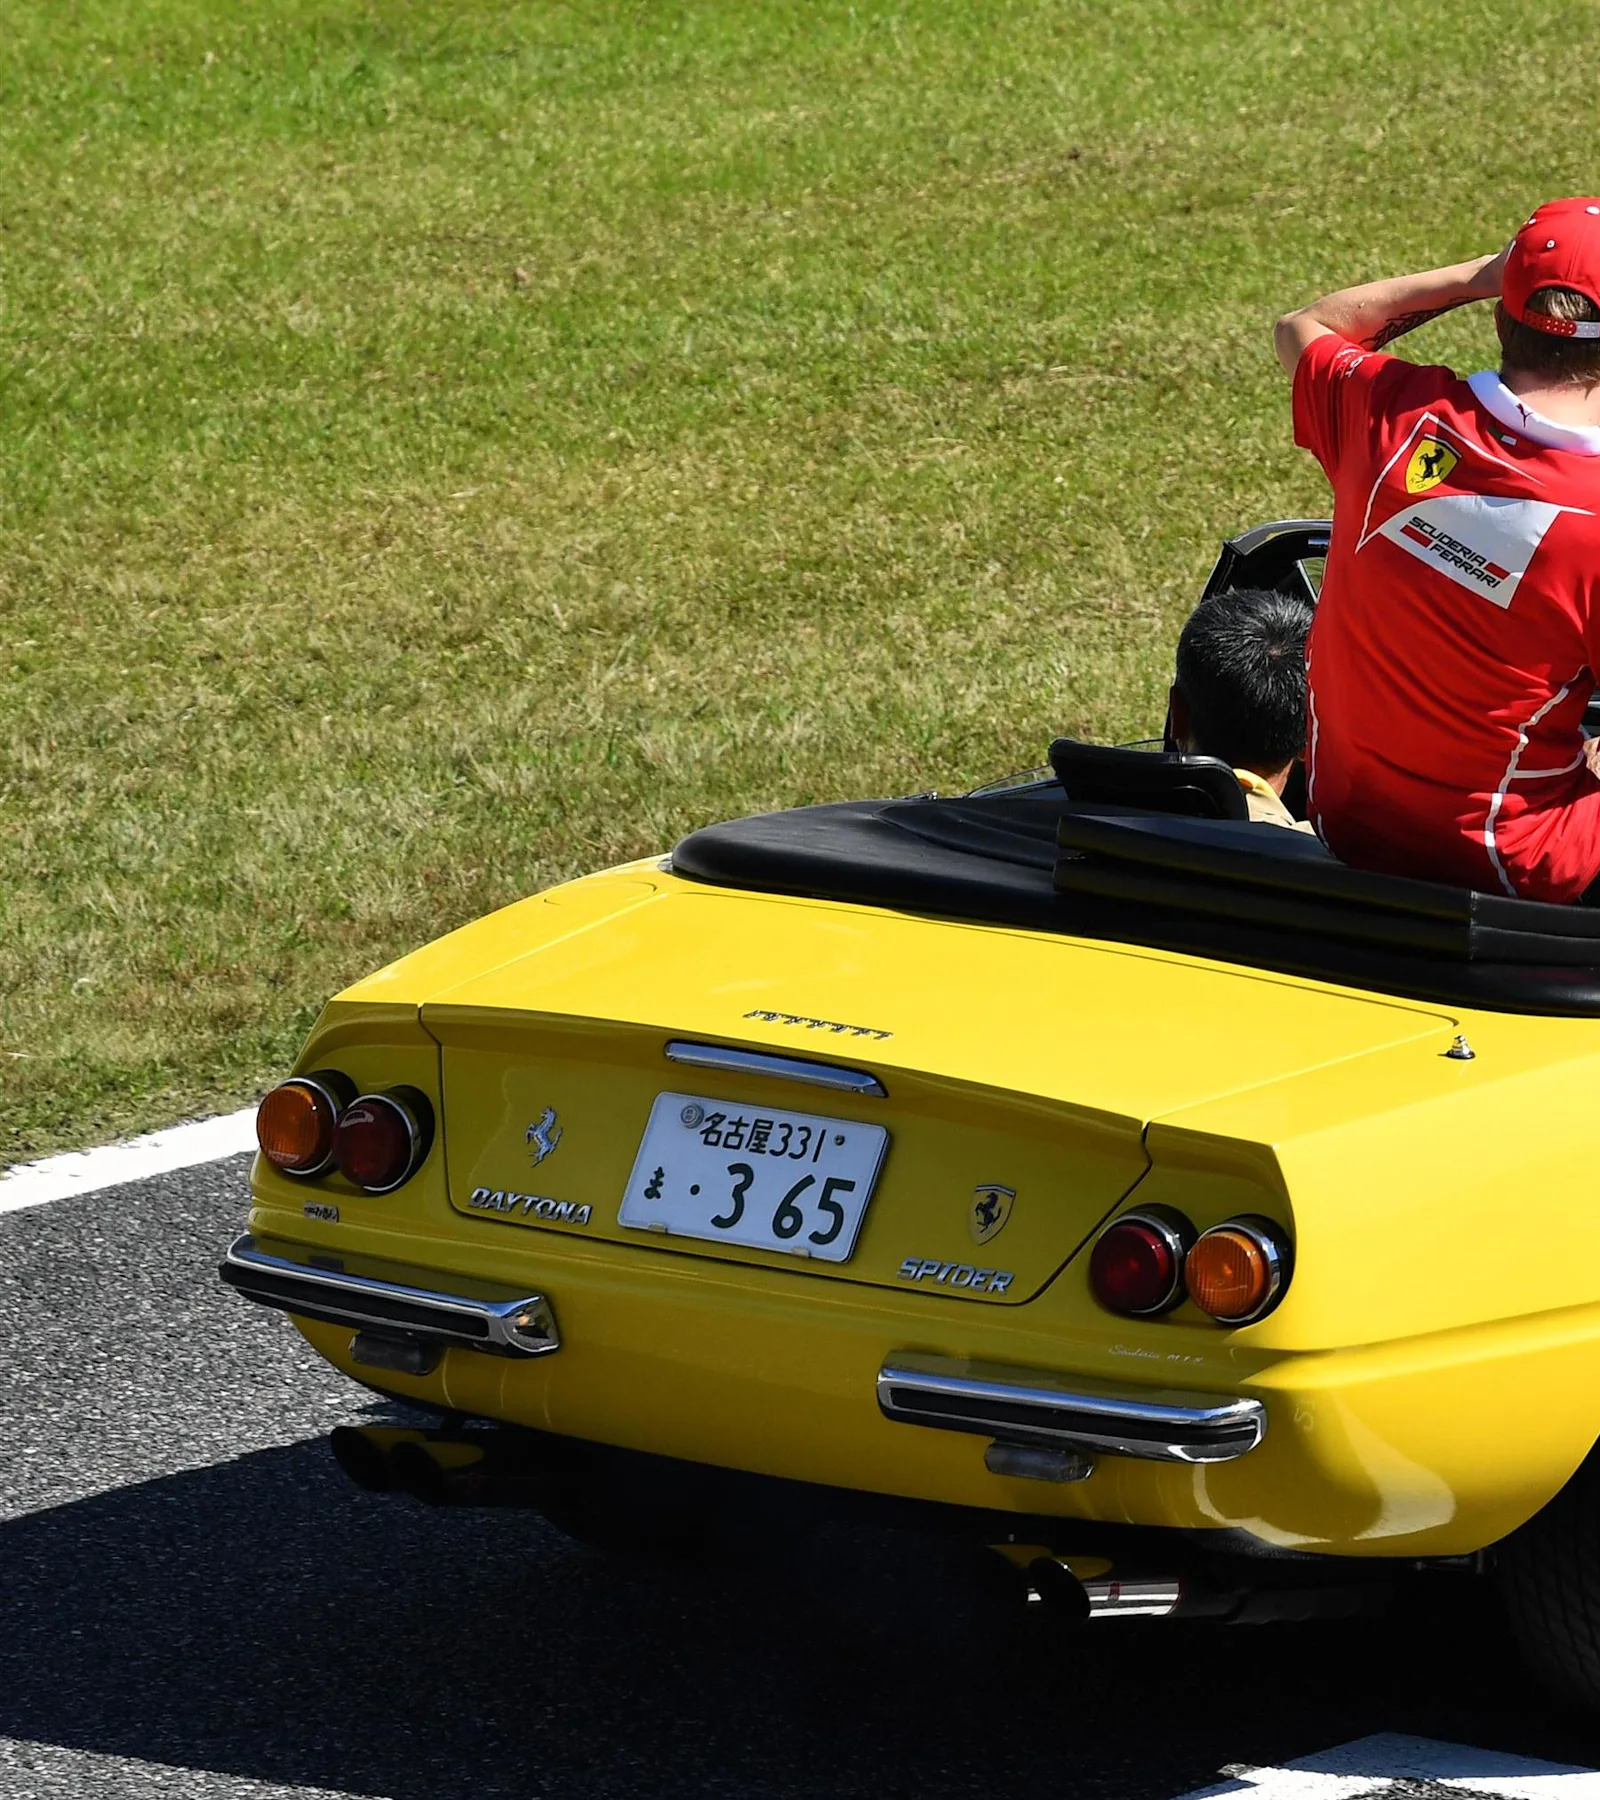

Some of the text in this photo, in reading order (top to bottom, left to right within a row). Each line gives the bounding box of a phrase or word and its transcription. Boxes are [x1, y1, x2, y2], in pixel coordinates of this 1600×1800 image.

[1408, 516, 1487, 567] SCUDERIA
[1429, 543, 1502, 589] FERRARI
[469, 1186, 592, 1226] DAYTONA
[896, 1257, 1015, 1295] SPIDER
